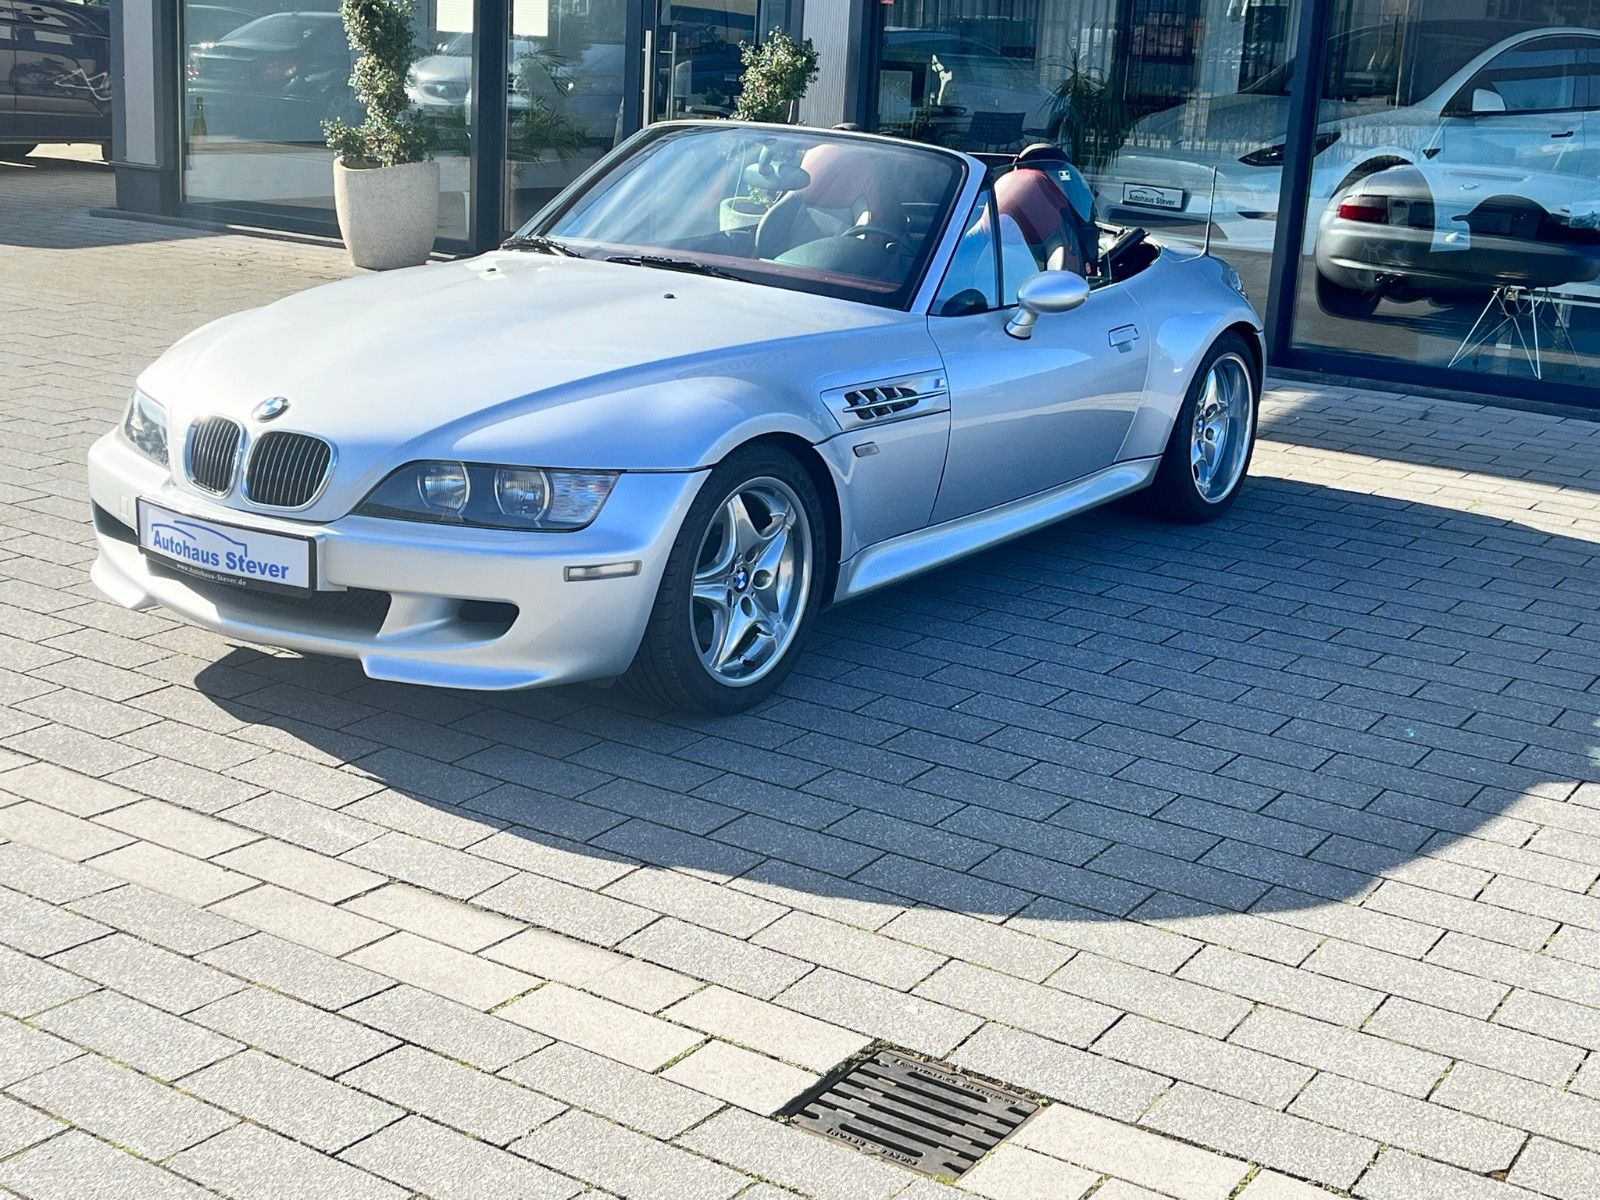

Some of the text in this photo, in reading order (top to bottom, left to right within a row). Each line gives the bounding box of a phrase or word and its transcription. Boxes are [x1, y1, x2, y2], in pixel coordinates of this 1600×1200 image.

[1129, 193, 1175, 206] Autohaus Stever
[154, 530, 290, 580] Autohaus Stever
